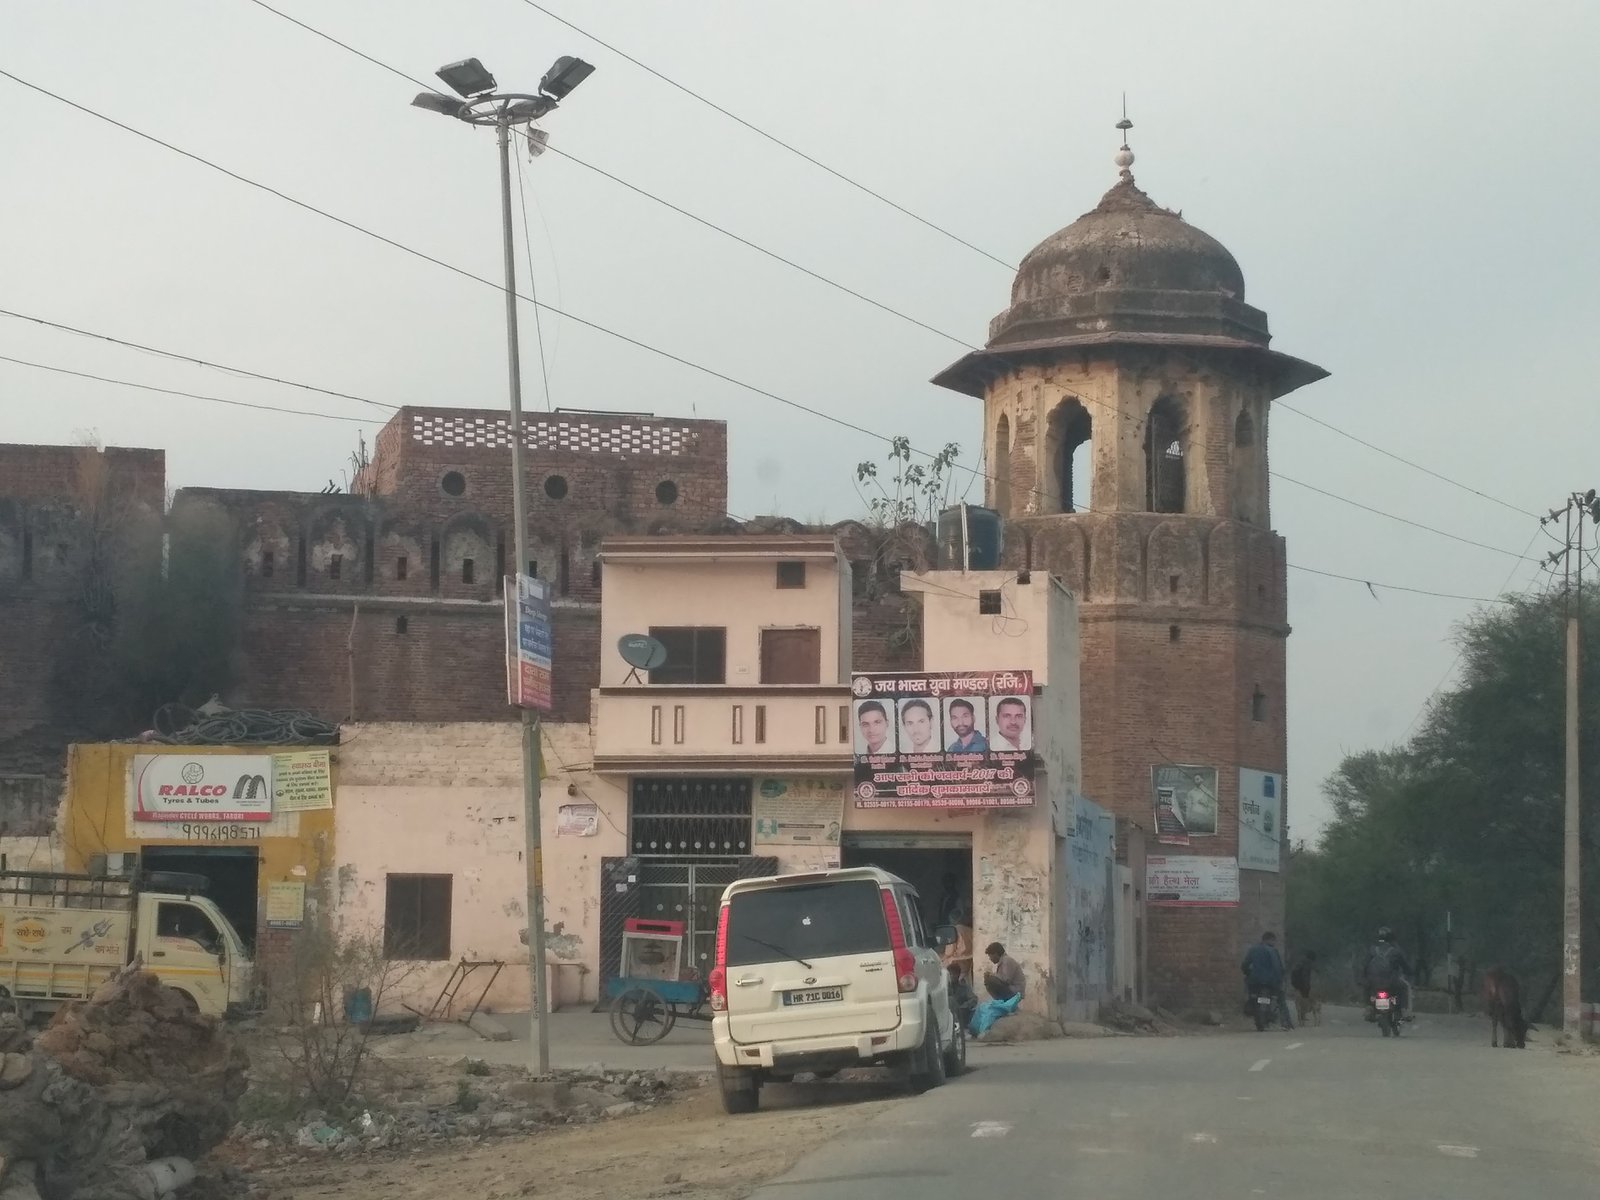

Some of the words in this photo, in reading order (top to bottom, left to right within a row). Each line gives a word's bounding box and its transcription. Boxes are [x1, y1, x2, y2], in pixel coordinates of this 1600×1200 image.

[874, 679, 896, 692] जय
[898, 678, 927, 692] भारत
[929, 677, 950, 696] युवा
[952, 677, 988, 691] मण्डल
[874, 772, 896, 783] आप
[896, 769, 918, 782] सभी
[918, 769, 935, 781] को
[997, 767, 1014, 780] की
[158, 784, 228, 796] RALCO
[896, 783, 930, 797] हार्दिक
[182, 823, 261, 840] 9996198571
[1183, 872, 1200, 886] मेला
[793, 994, 804, 1003] HR
[805, 992, 821, 1001] 71C
[821, 990, 841, 1000] 0016
